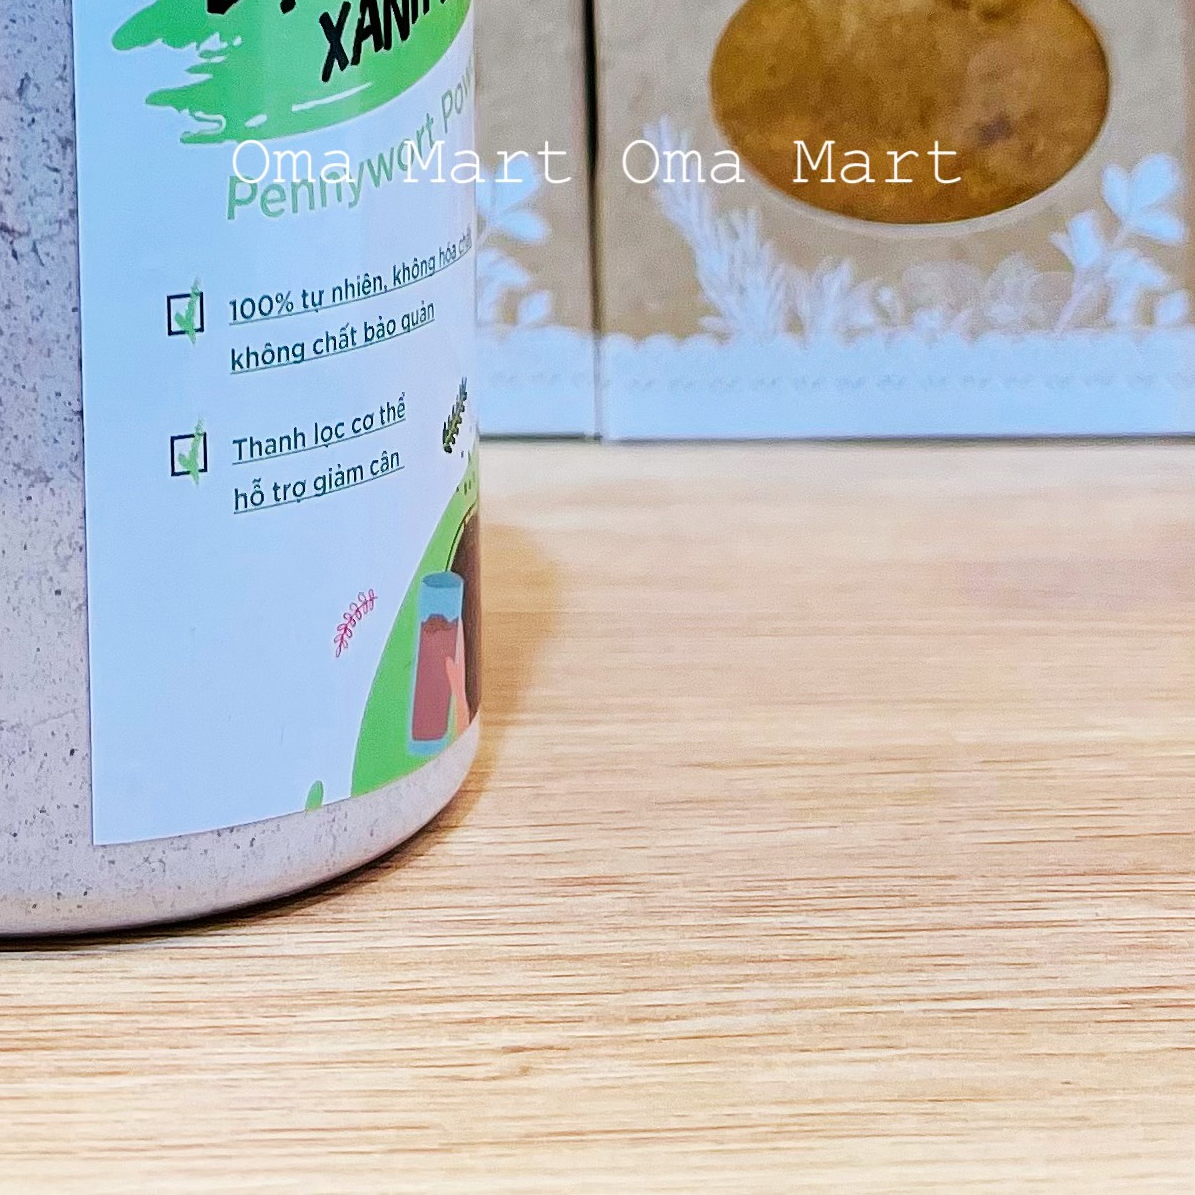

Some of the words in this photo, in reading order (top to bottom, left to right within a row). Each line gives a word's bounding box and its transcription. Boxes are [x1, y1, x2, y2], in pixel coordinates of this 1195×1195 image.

[226, 113, 434, 221] Pennywort
[229, 291, 294, 322] 100%
[301, 288, 325, 312] tự
[332, 273, 388, 305] nhiên,
[392, 256, 436, 287] không
[231, 341, 306, 371] không
[312, 322, 357, 356] chất
[363, 316, 397, 344] bảo
[401, 300, 436, 333] quản
[232, 427, 306, 462] Thanh
[314, 419, 345, 448] lọc
[351, 412, 376, 435] cơ
[379, 392, 407, 424] thể
[234, 478, 265, 511] hỗ
[272, 479, 307, 504] trợ
[313, 461, 365, 498] giảm
[369, 450, 401, 478] cân
